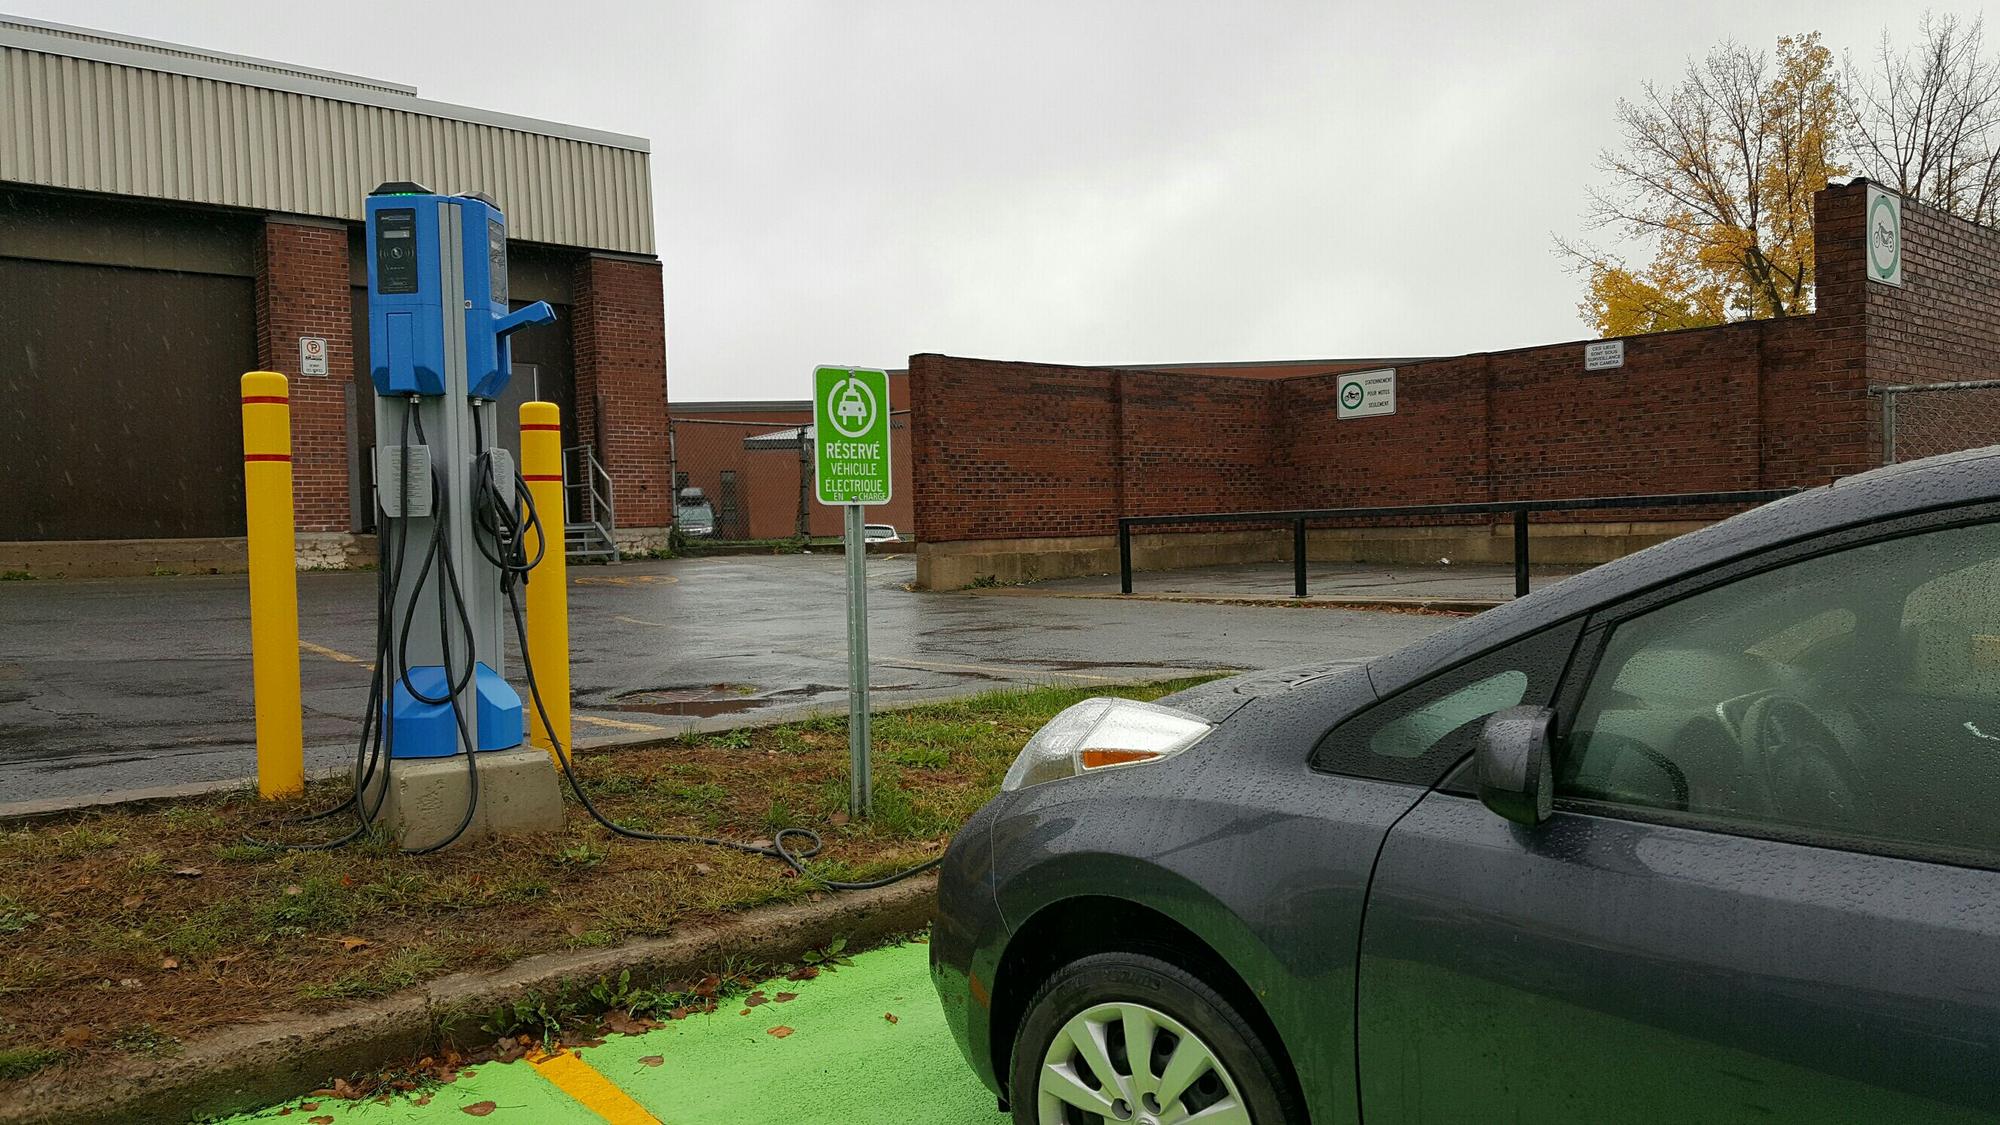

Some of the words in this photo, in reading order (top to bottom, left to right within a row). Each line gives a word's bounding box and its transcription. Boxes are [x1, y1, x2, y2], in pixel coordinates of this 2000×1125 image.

[1368, 400, 1389, 408] SEULEMENT
[826, 440, 880, 460] RÉSERVÉ
[831, 460, 877, 476] VÉHICULE
[825, 477, 883, 492] ÉLECTRIQUE
[833, 492, 844, 501] EN
[858, 492, 886, 501] CHARGE
